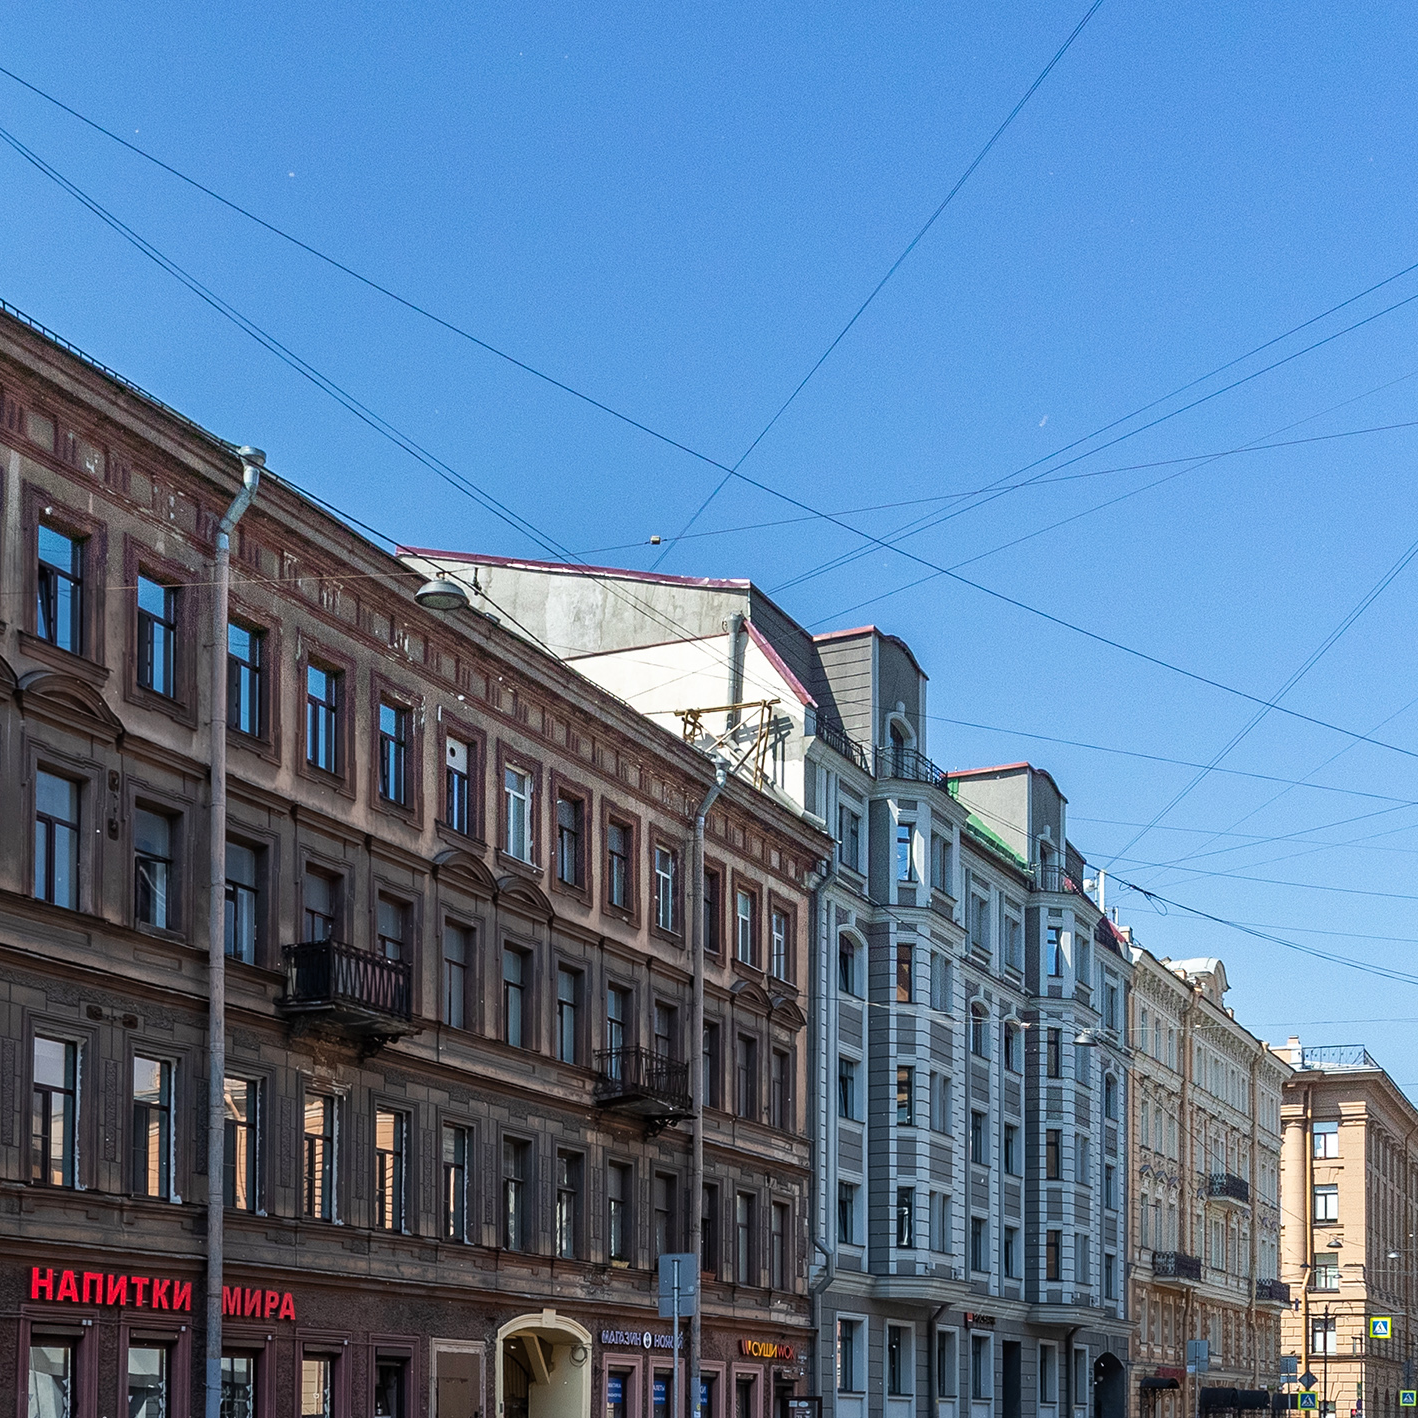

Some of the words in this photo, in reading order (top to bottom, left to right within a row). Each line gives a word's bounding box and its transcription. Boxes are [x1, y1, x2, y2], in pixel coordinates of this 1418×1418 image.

[31, 1267, 193, 1311] НАПИТКИ
[221, 1285, 296, 1321] МИРА
[654, 1332, 684, 1350] НОЖЙ
